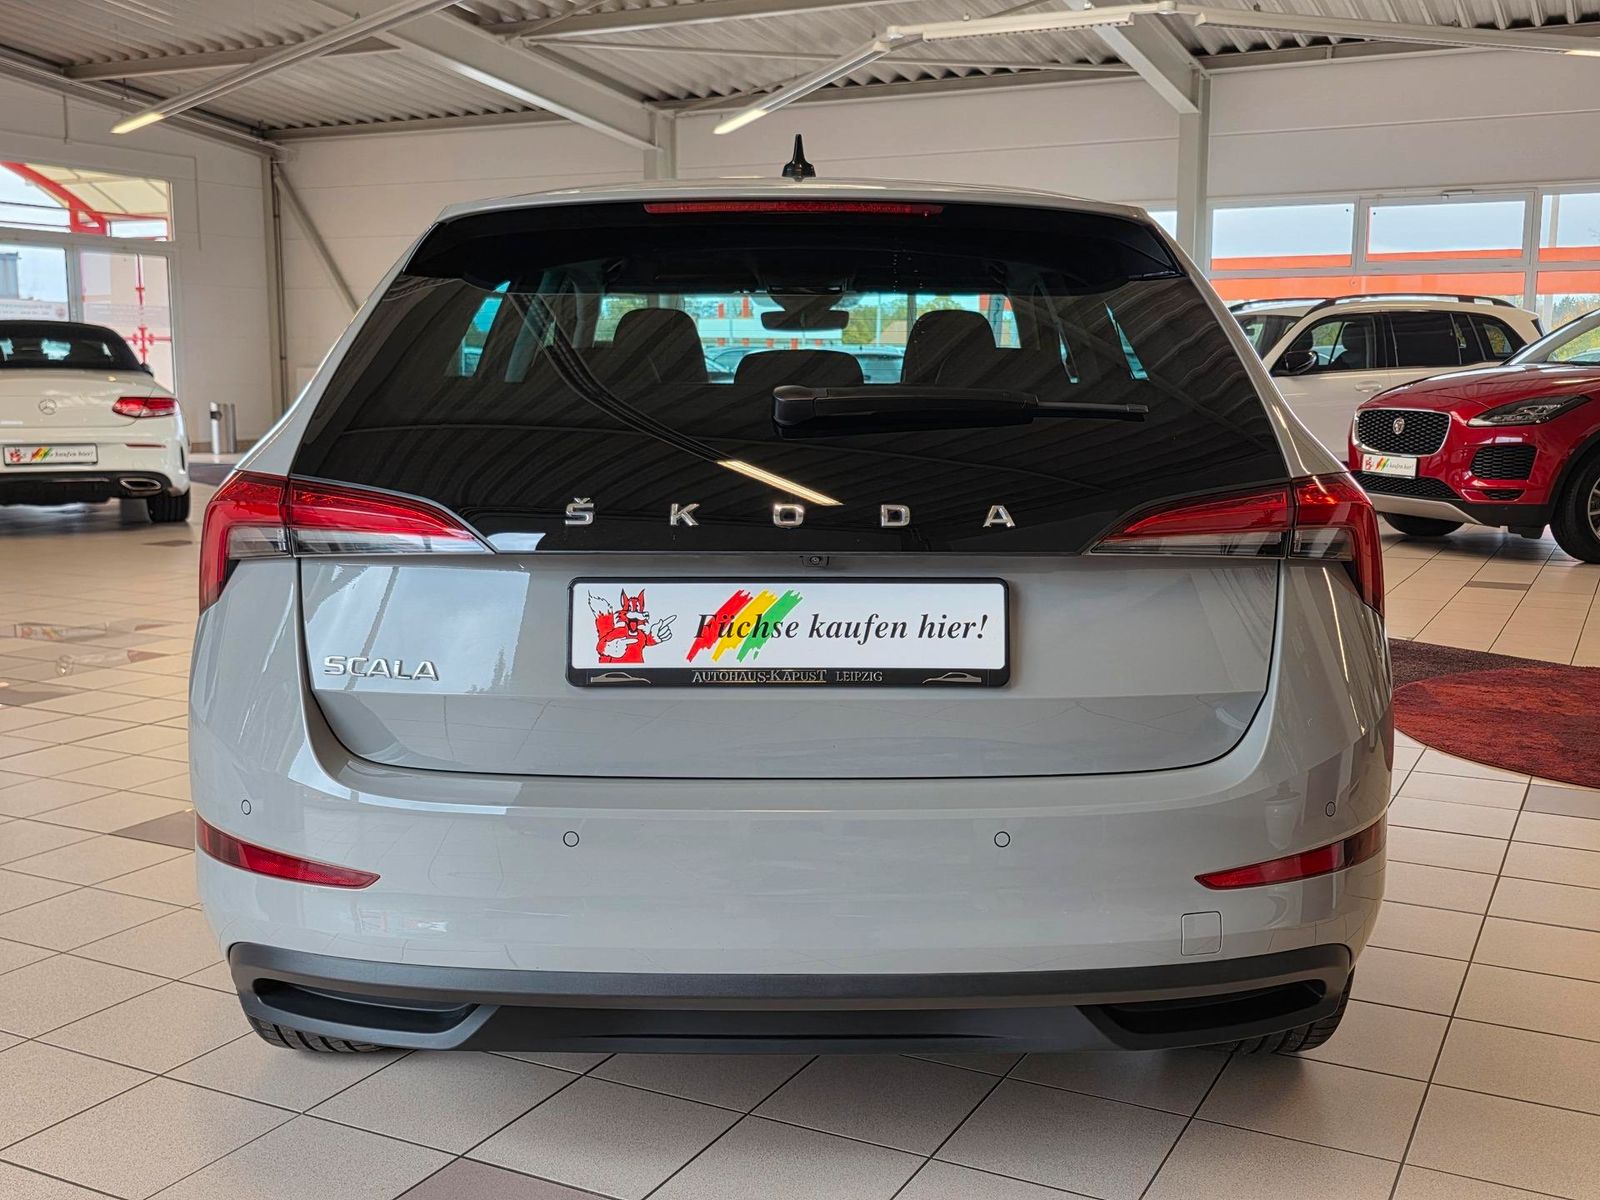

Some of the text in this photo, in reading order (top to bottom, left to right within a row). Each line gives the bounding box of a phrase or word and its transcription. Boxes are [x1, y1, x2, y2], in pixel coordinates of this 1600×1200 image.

[565, 497, 1016, 528] ŠKODA
[694, 613, 988, 645] Füchse kaufen hier!
[323, 655, 439, 681] SCALA
[836, 671, 883, 682] LEIPZIG
